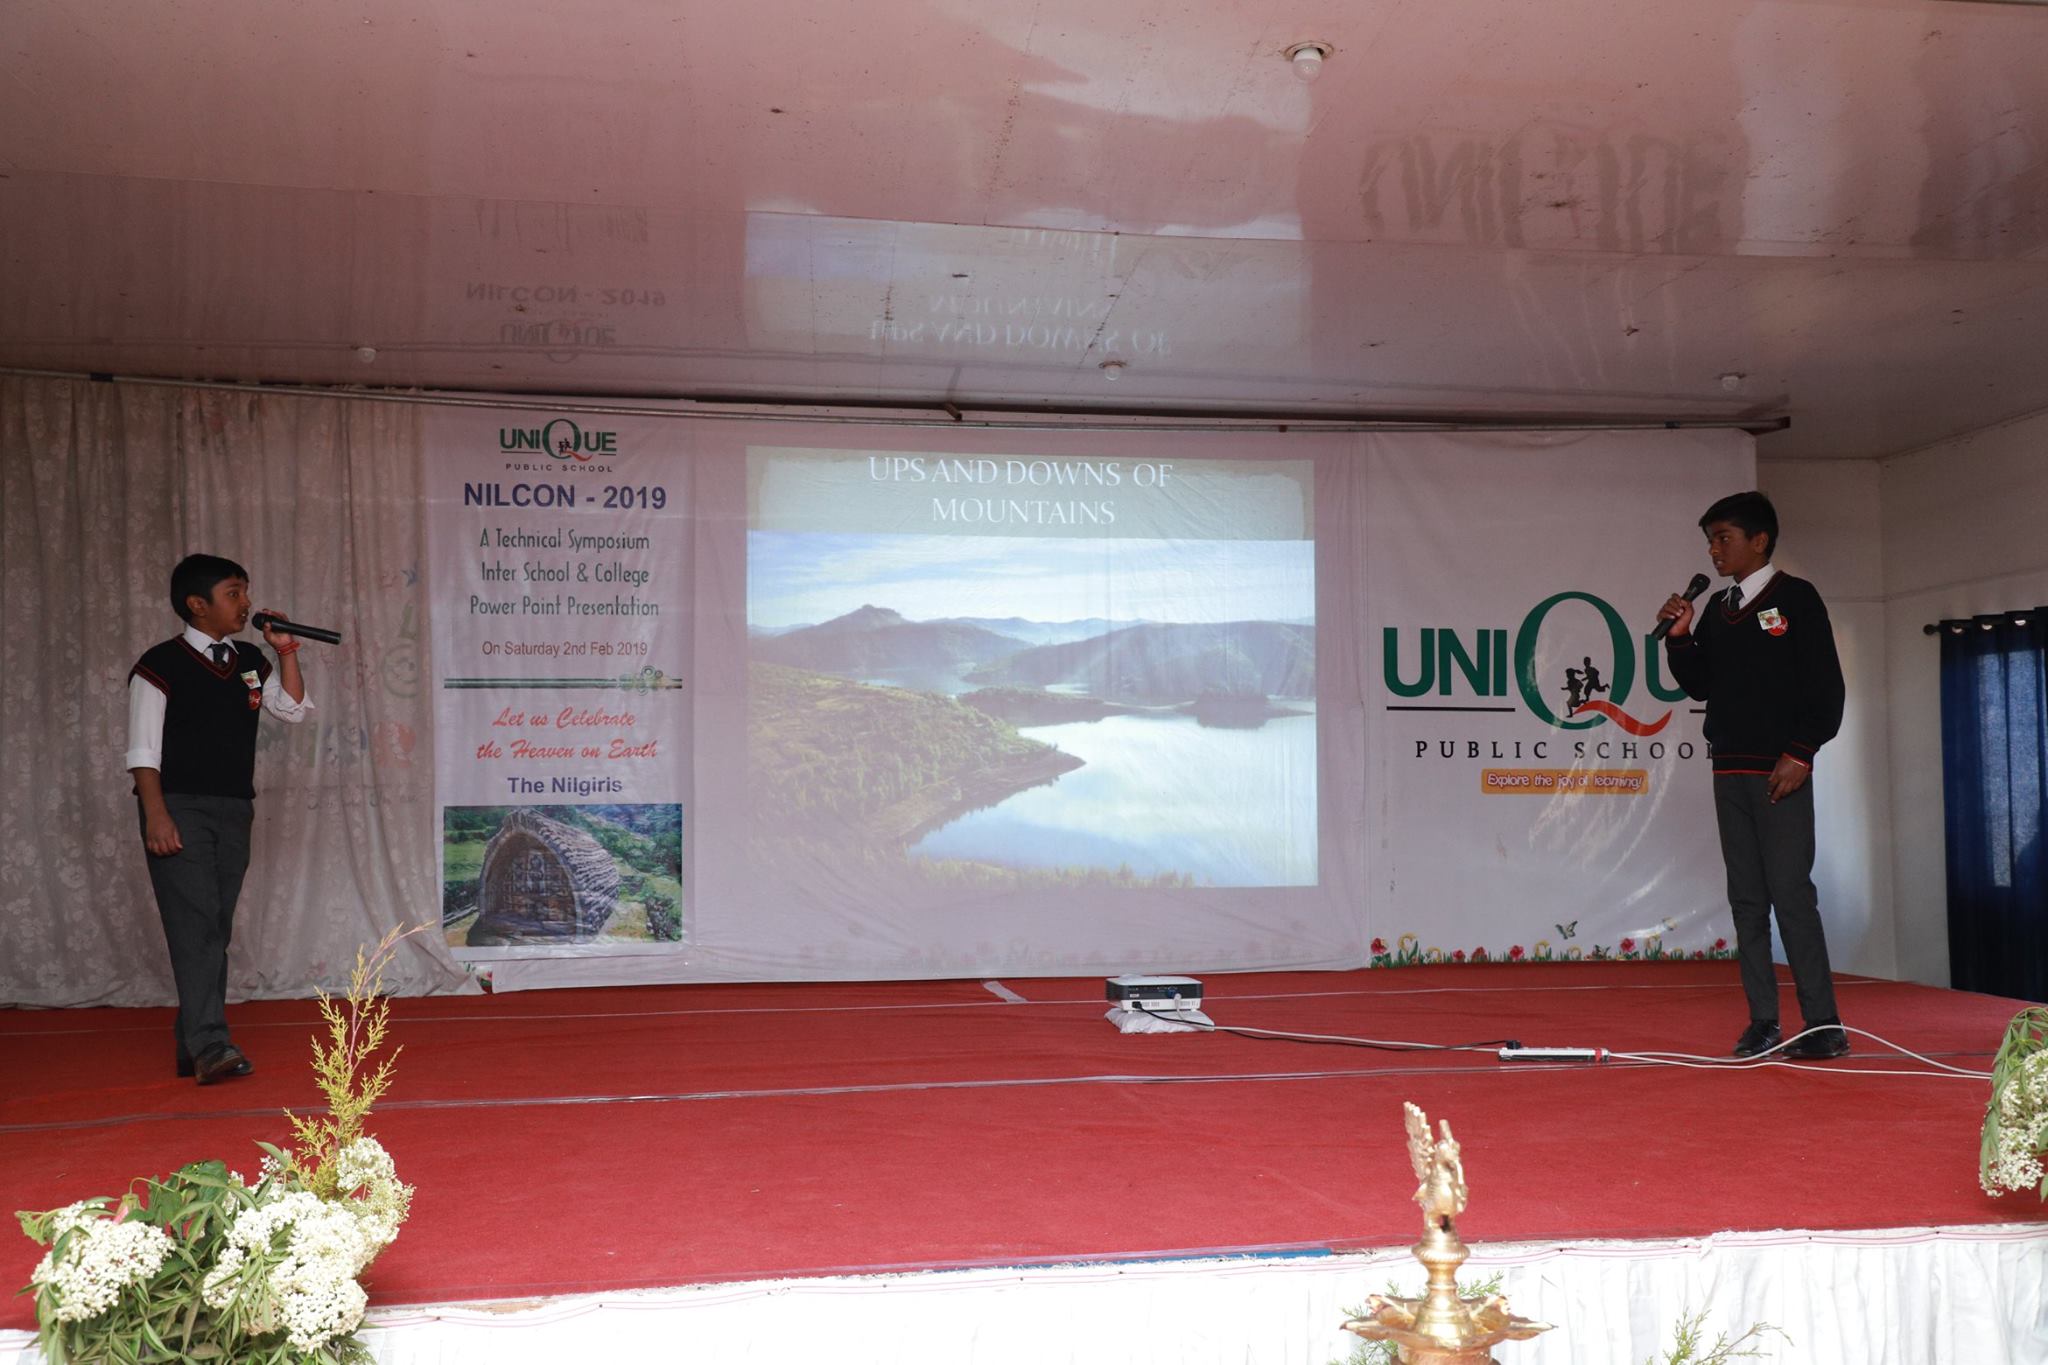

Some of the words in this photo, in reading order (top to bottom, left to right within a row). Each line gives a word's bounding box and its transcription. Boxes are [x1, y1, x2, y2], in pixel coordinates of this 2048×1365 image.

[500, 419, 617, 461] UNIQUE
[505, 463, 553, 472] PUBLIC
[562, 464, 613, 473] SCHOOL
[868, 456, 926, 482] UPS
[931, 458, 998, 484] AND
[1006, 459, 1121, 487] DOWNS
[1133, 462, 1174, 488] OF
[464, 482, 575, 508] NILCON
[603, 485, 666, 510] 2019
[931, 497, 1116, 525] MOUNTAINS
[480, 528, 490, 548] A
[496, 527, 562, 549] Technical
[568, 529, 650, 554] Symposium
[481, 561, 517, 582] Inter
[523, 561, 570, 583] School
[576, 563, 589, 582] &
[595, 563, 649, 587] College
[470, 595, 516, 616] Power
[523, 595, 561, 615] Point
[567, 596, 659, 616] Presentation
[482, 641, 501, 656] On
[504, 641, 560, 659] Saturday
[563, 641, 585, 656] 2nd
[590, 641, 613, 656] Feb
[617, 642, 648, 656] 2019
[492, 706, 524, 727] Let
[530, 713, 548, 726] us
[556, 706, 636, 729] Celebrate
[476, 741, 502, 760] the
[510, 739, 575, 759] Heaven
[581, 747, 601, 759] on
[607, 738, 658, 759] Earth
[1415, 740, 1548, 759] PUBLIC
[507, 777, 545, 793] The
[551, 777, 623, 797] Nilgiris
[1487, 773, 1530, 788] Explore
[1534, 774, 1552, 786] the
[1557, 774, 1575, 790] joy
